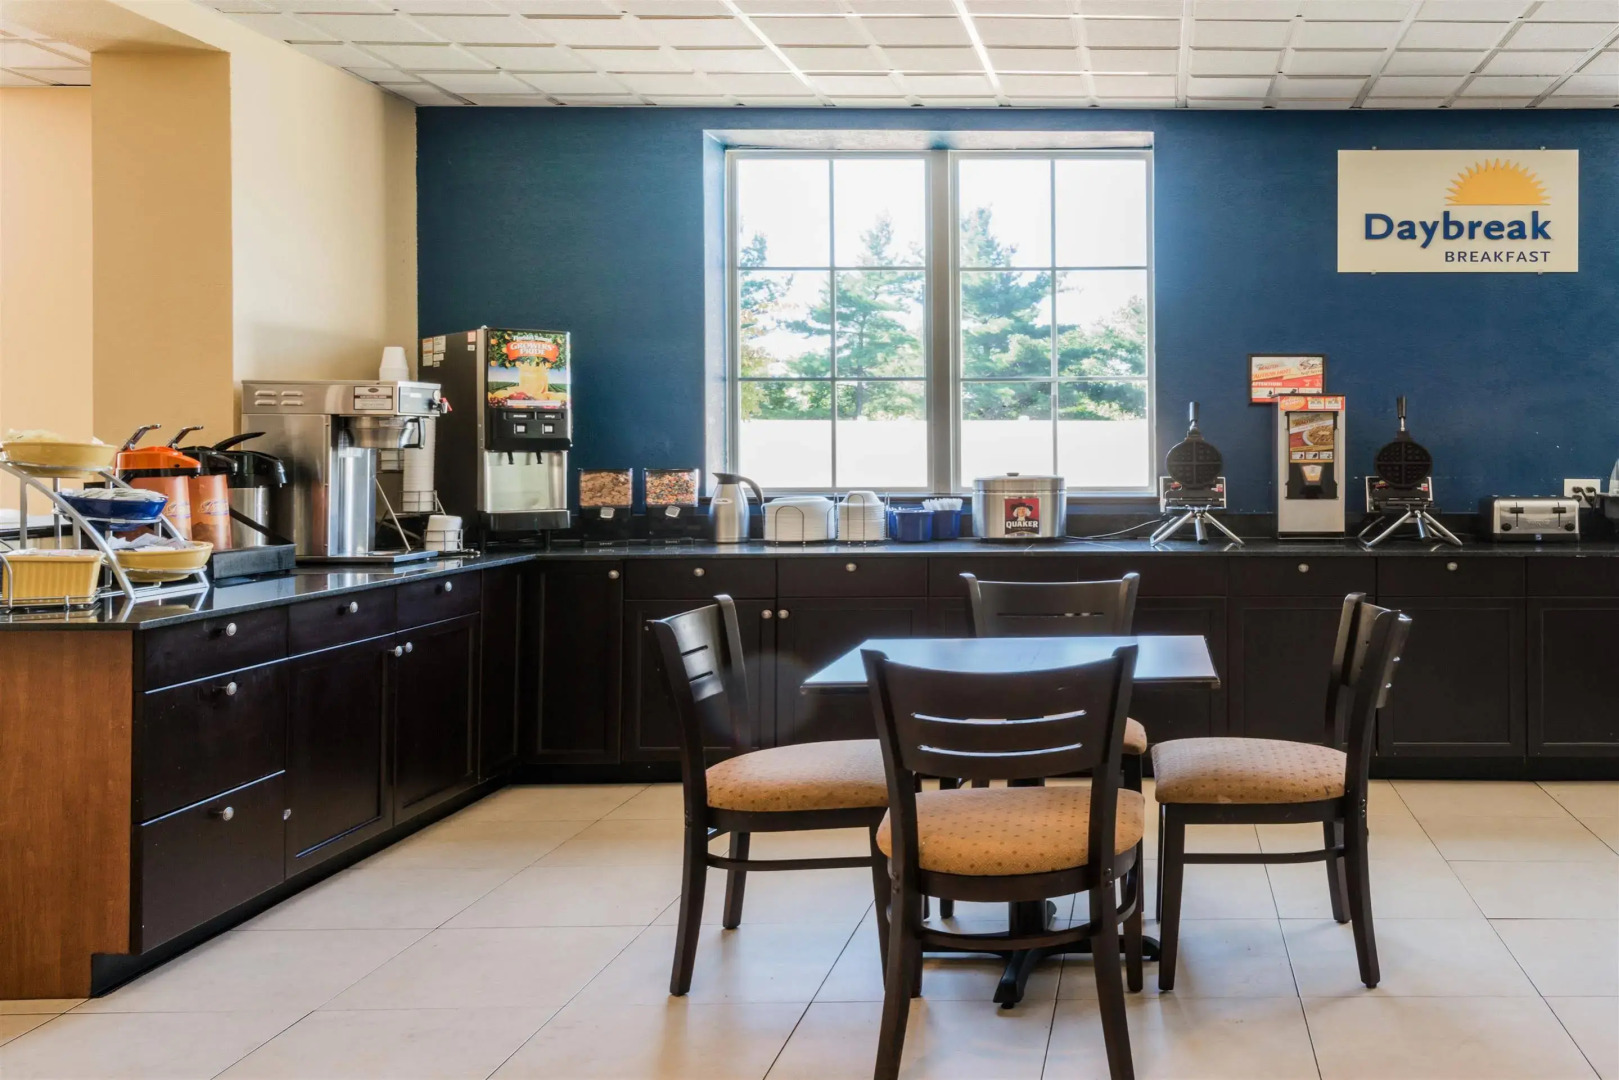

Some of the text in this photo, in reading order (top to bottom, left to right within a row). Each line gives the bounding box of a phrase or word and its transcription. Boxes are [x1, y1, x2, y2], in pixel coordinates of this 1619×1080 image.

[1364, 210, 1552, 249] Daybreak
[1444, 251, 1551, 263] BREAKFAST
[1005, 520, 1039, 529] QUAKER
